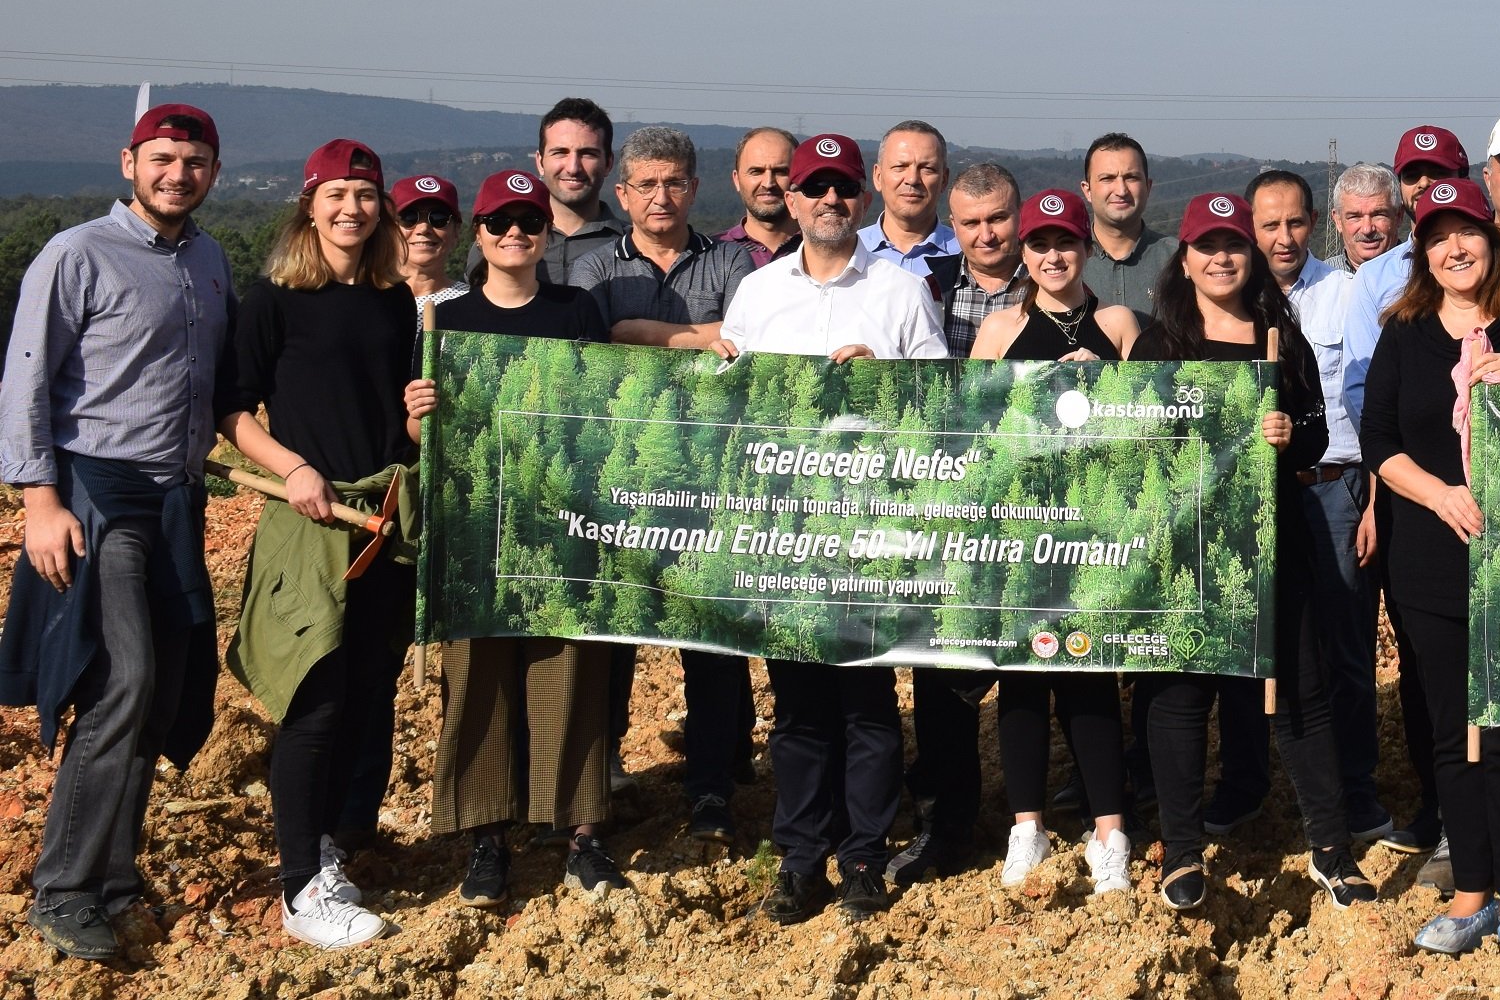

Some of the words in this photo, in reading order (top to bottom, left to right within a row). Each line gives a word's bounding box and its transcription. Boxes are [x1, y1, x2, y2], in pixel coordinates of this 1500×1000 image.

[1177, 386, 1204, 404] 50
[1093, 399, 1204, 419] kastamonu
[746, 442, 886, 485] "Geleceğe
[891, 447, 981, 481] Nefes"
[609, 487, 697, 510] Yaşanabilir
[701, 493, 722, 509] bir
[726, 494, 767, 514] hayat
[772, 495, 798, 514] için
[803, 497, 865, 518] toprağa,
[869, 499, 919, 518] fidana,
[924, 502, 987, 522] geleceğe
[991, 503, 1084, 524] dokunuyoruz.
[558, 509, 723, 554] "Kastamonu
[731, 523, 841, 563] Entegre
[849, 530, 890, 559] 50.
[903, 531, 938, 561] Yıl
[941, 531, 1025, 563] Hatıra
[1033, 534, 1145, 566] Ormanı"
[734, 571, 754, 588] ile
[758, 572, 827, 594] geleceğe
[831, 575, 883, 595] yatırım
[888, 579, 961, 598] yapıyoruz.
[929, 636, 1018, 649] gelecegenefes.com
[1128, 645, 1168, 656] NEFES
